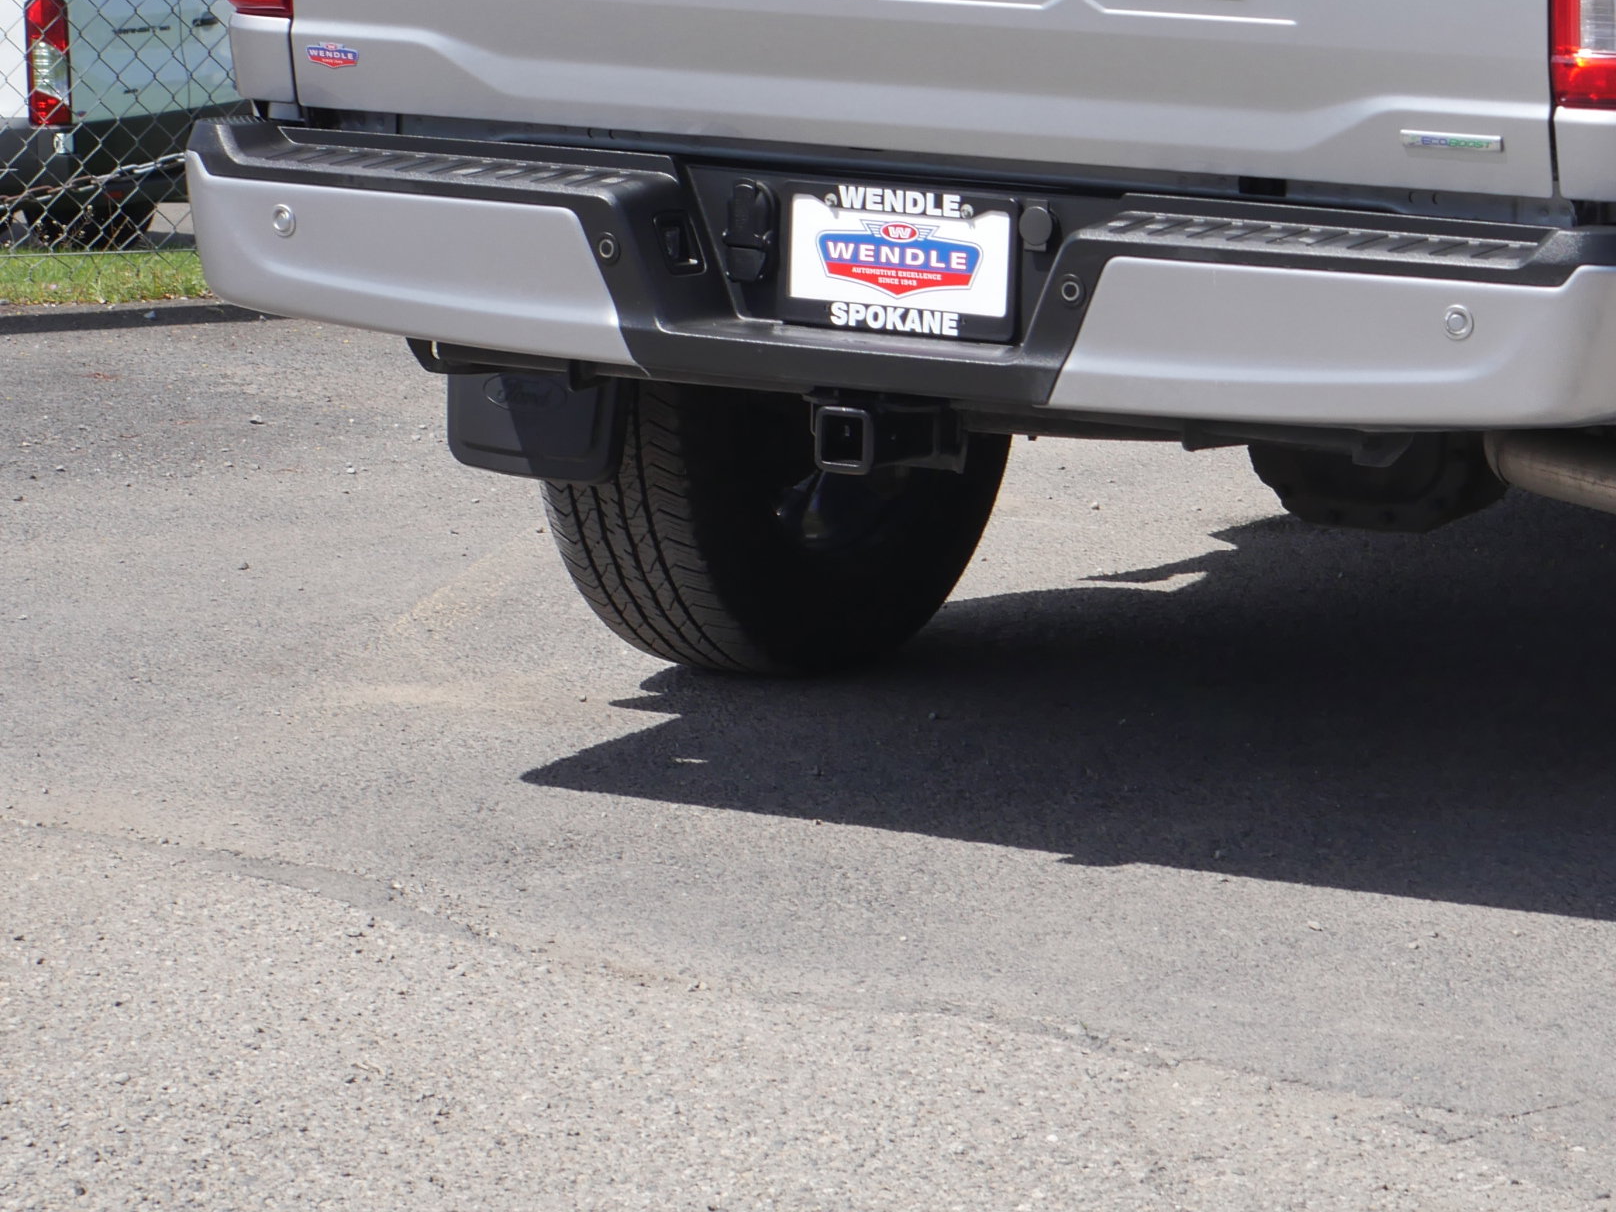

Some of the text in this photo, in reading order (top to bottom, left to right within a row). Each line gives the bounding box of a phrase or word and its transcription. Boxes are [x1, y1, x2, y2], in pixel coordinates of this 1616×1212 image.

[309, 49, 354, 60] WENDLE
[837, 185, 962, 218] WENDLE
[826, 241, 967, 270] WENDLE
[852, 267, 942, 281] AUTOMOTIVE EXCELLENCE
[878, 277, 900, 285] SINCE
[830, 302, 959, 337] SPOKANE
